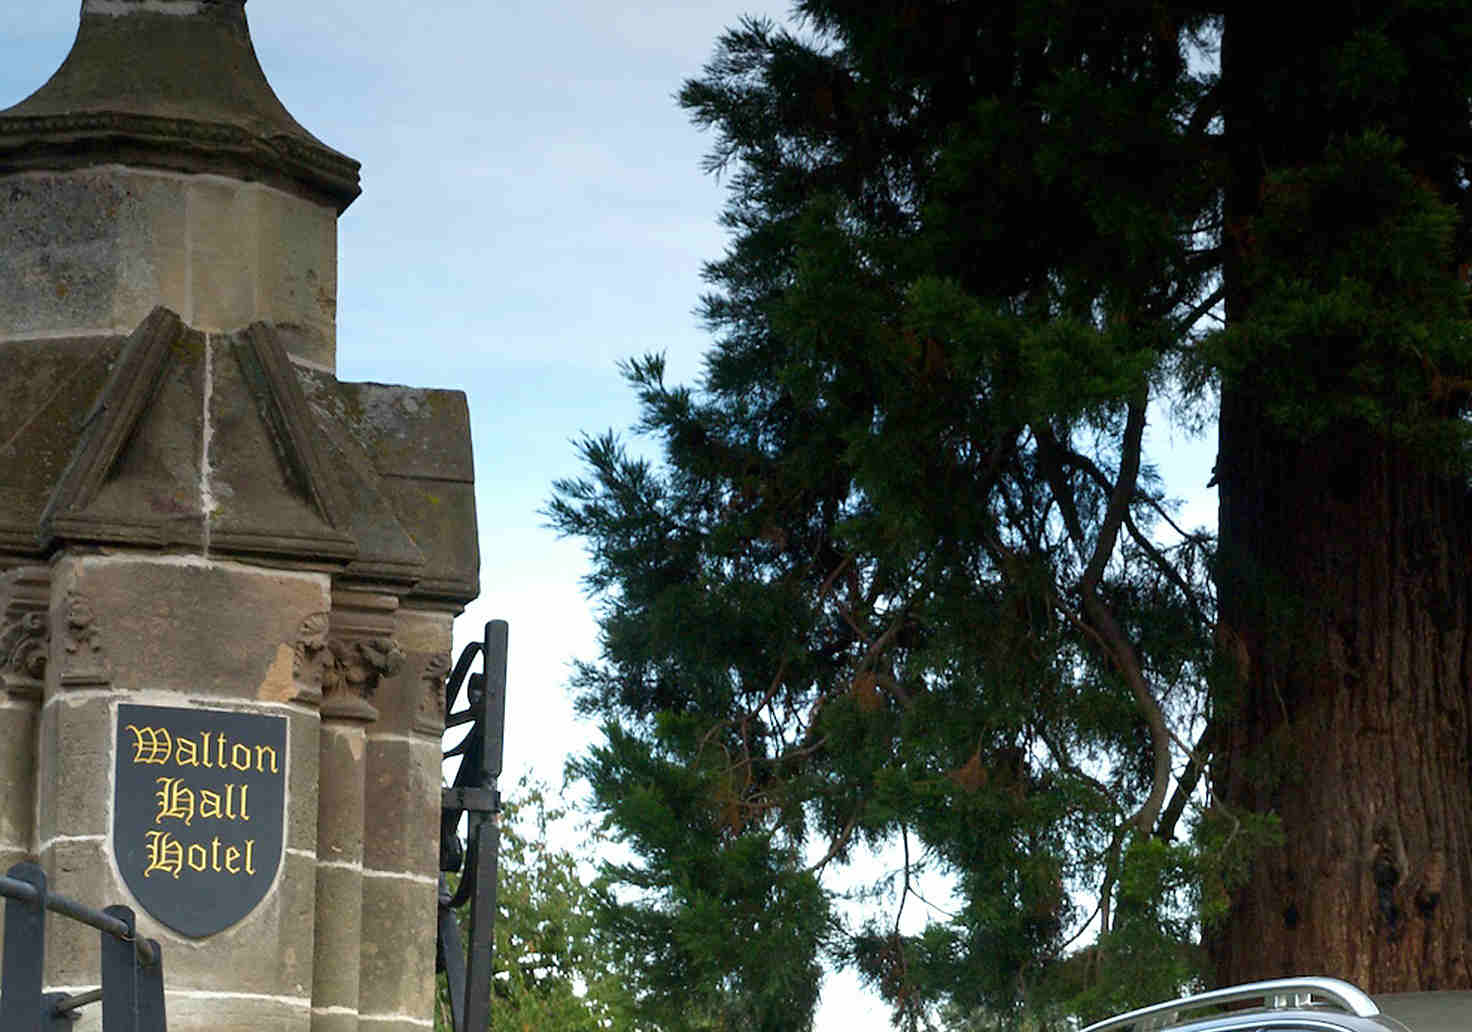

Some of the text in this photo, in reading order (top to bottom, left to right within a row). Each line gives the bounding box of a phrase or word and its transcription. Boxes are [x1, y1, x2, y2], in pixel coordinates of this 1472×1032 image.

[126, 723, 280, 774] Walton
[155, 776, 251, 826] Hall
[143, 830, 257, 880] Hotel
